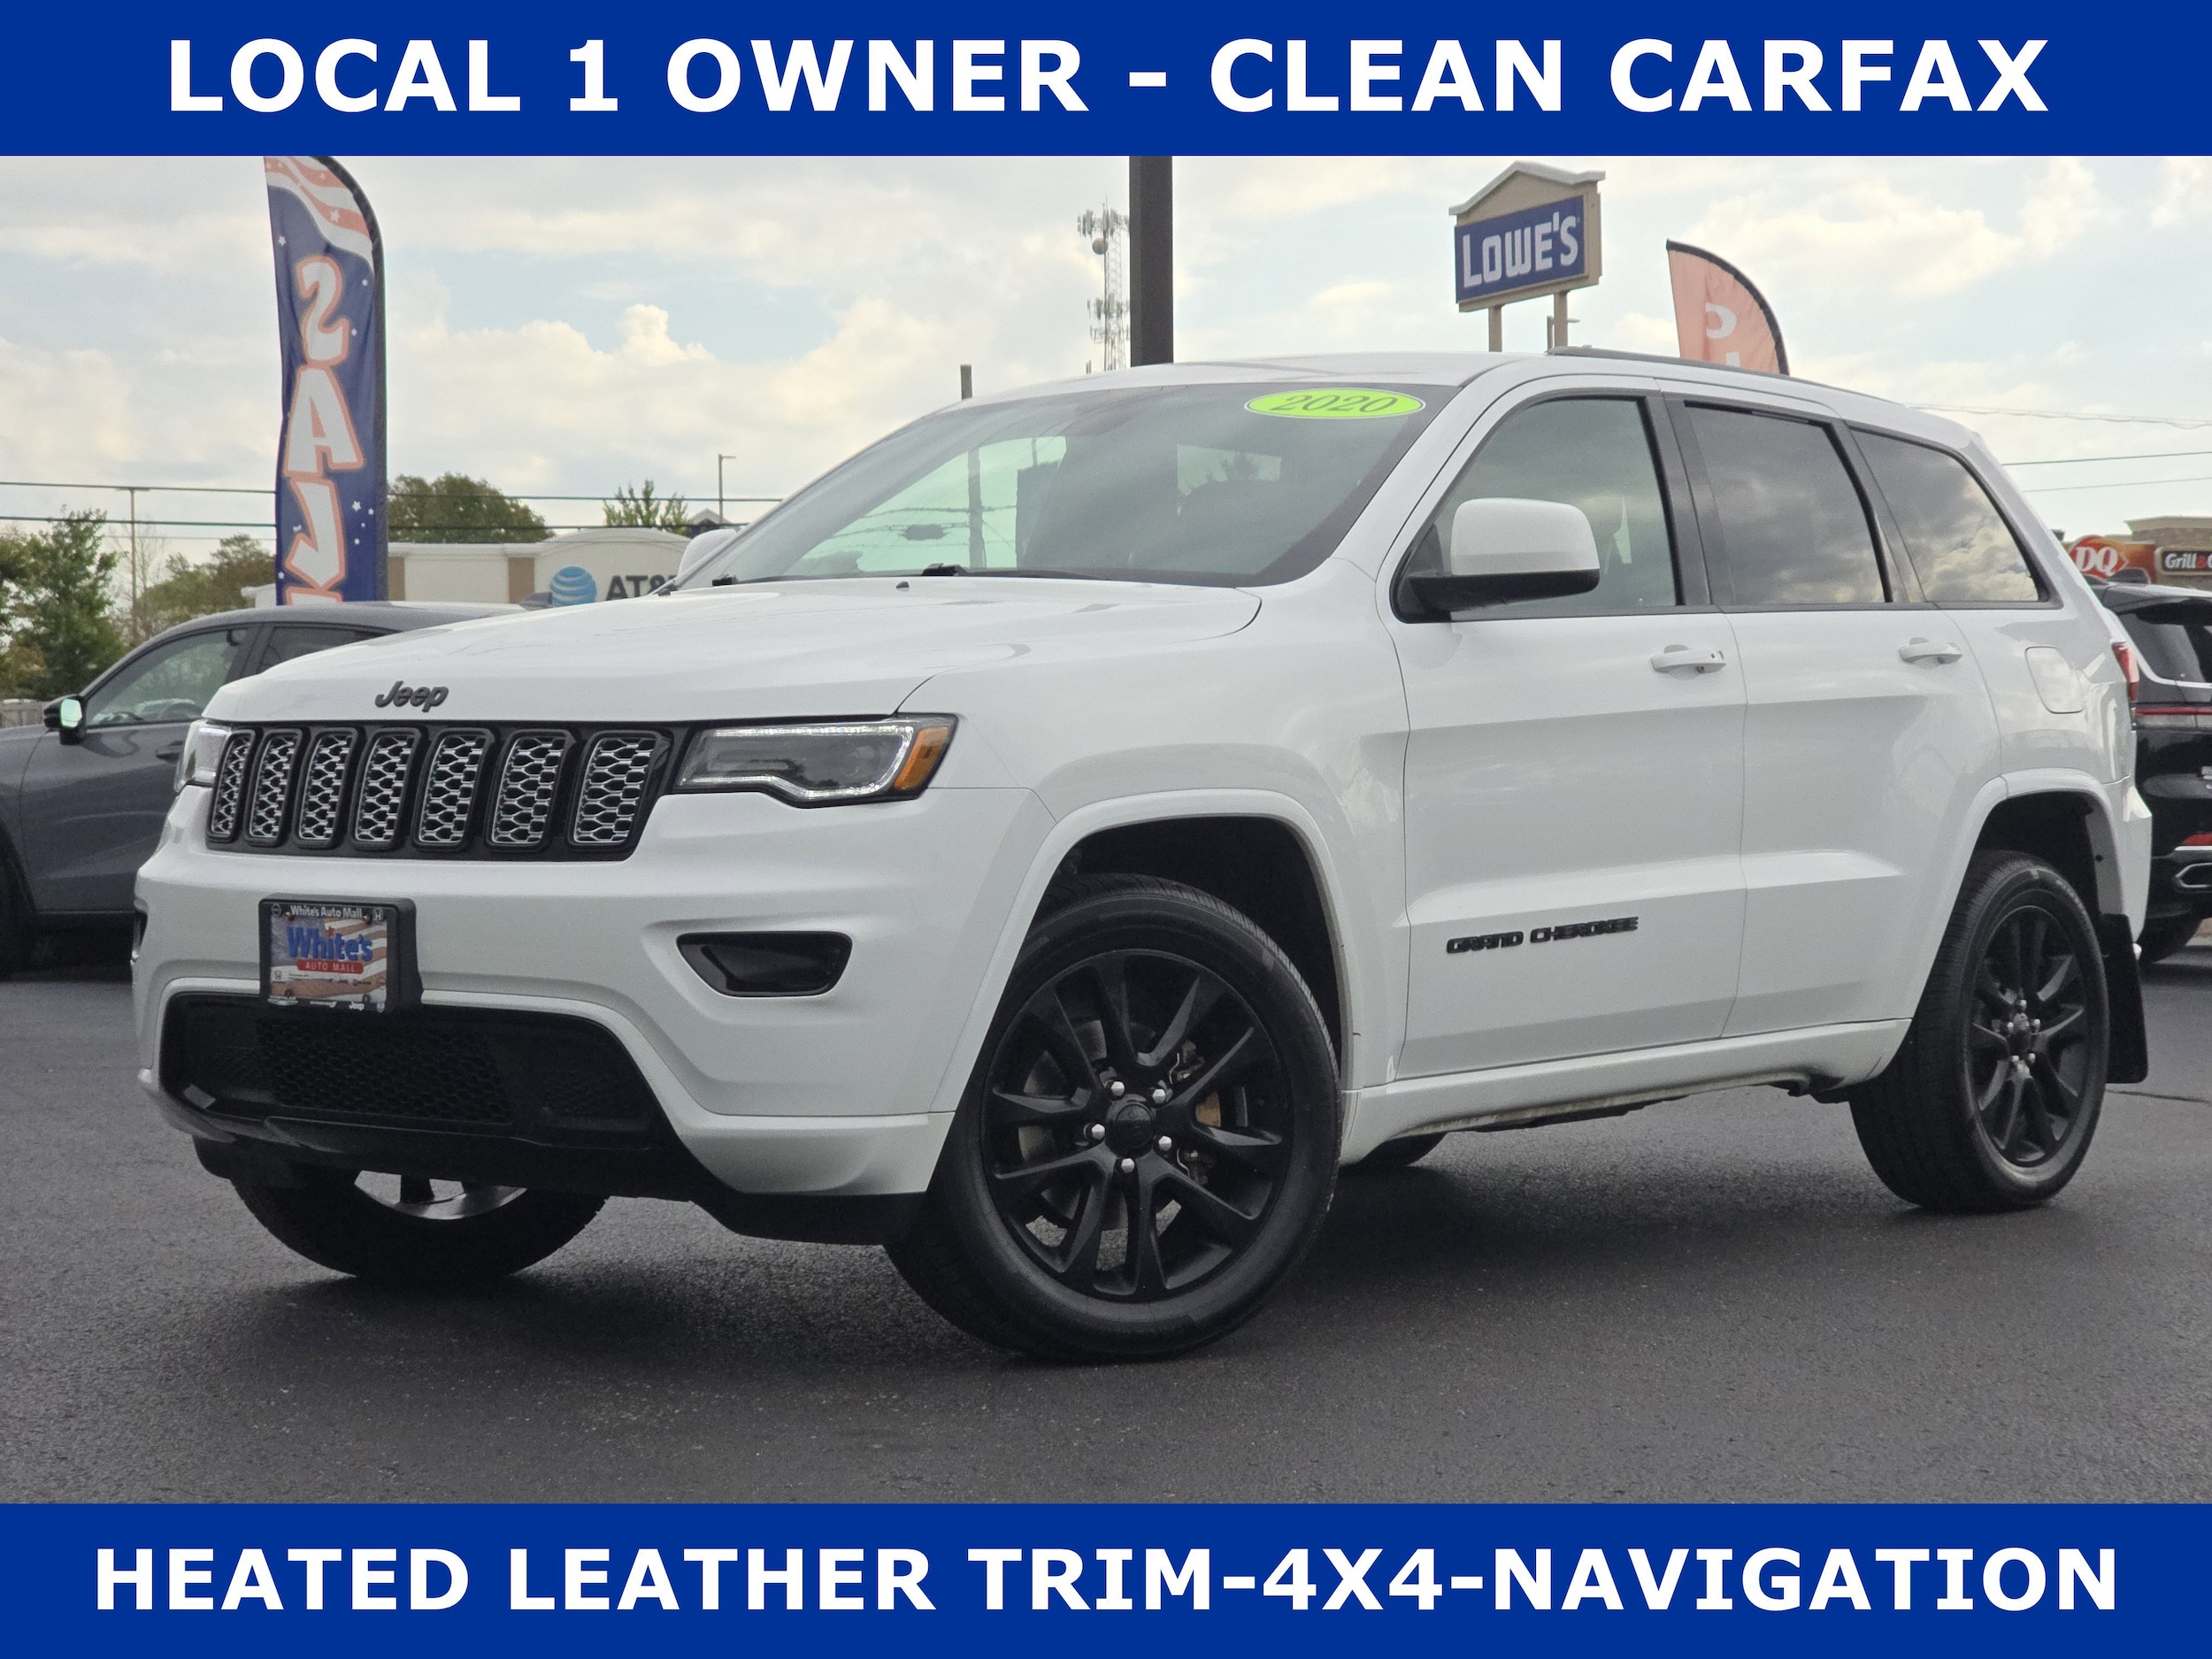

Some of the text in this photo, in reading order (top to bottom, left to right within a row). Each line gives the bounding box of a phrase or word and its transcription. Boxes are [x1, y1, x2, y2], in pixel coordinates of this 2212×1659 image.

[1463, 211, 1578, 288] LOWE'S
[1269, 394, 1399, 412] 2020
[2074, 546, 2119, 577] DQ
[374, 680, 449, 713] Jeep
[290, 904, 363, 918] White's Auto Mall
[287, 926, 373, 962] White's
[1447, 916, 1639, 954] GRAND CHEROKEE
[305, 961, 356, 972] AUTO MALL
